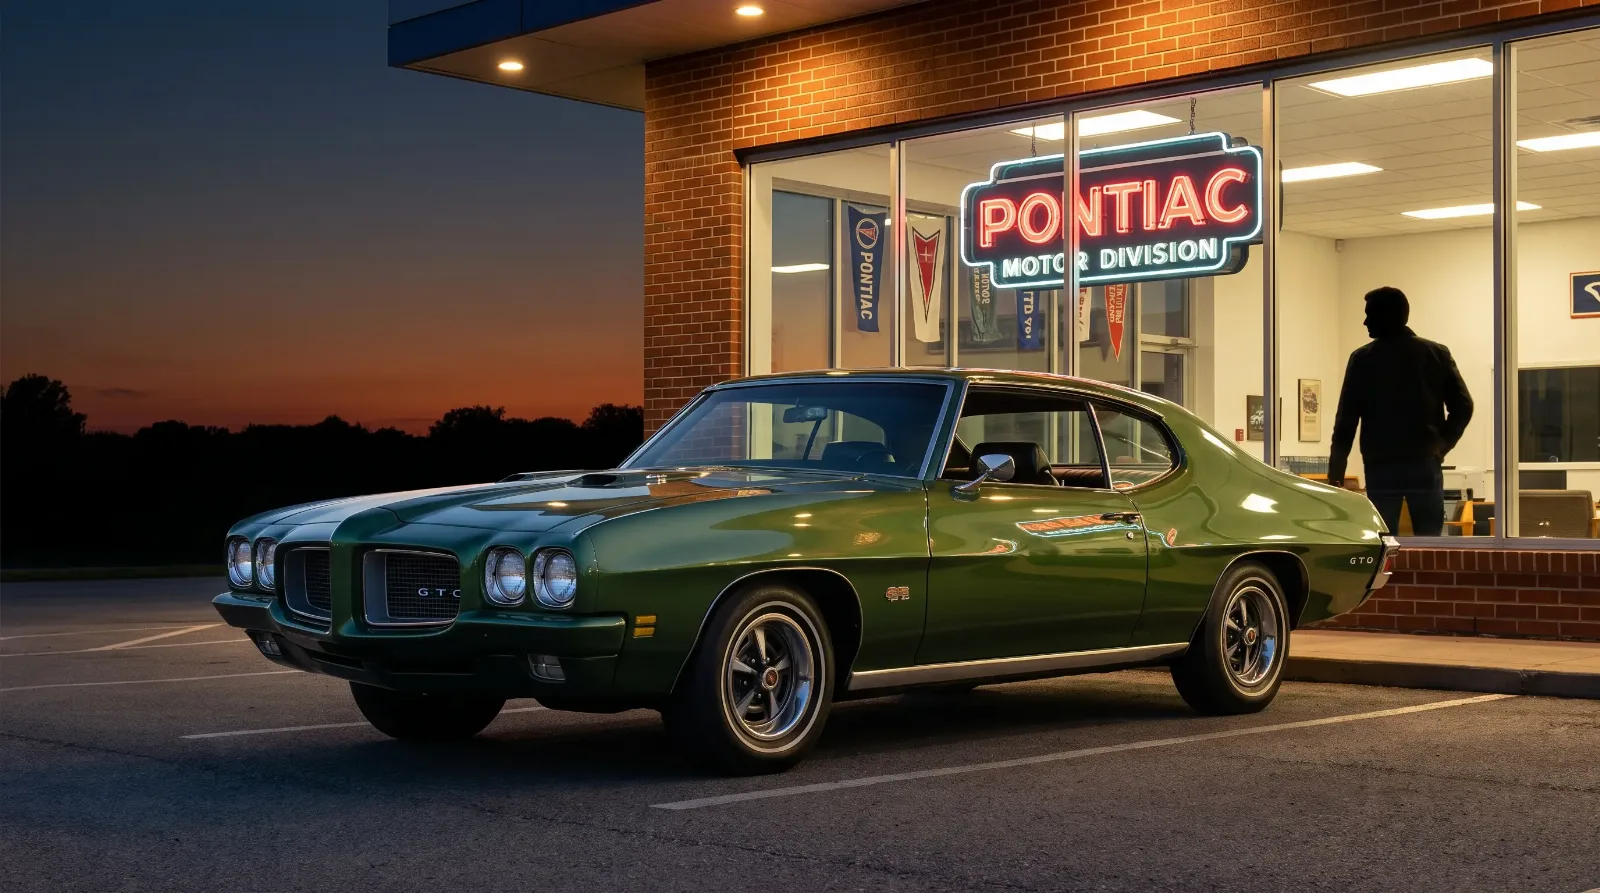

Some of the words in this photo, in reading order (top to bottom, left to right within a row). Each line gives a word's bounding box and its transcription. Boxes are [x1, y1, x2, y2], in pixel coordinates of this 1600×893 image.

[979, 168, 1249, 248] PONTIAC
[1100, 237, 1218, 270] DIVISION
[859, 251, 874, 320] PONTIAC
[1349, 556, 1374, 565] GTO
